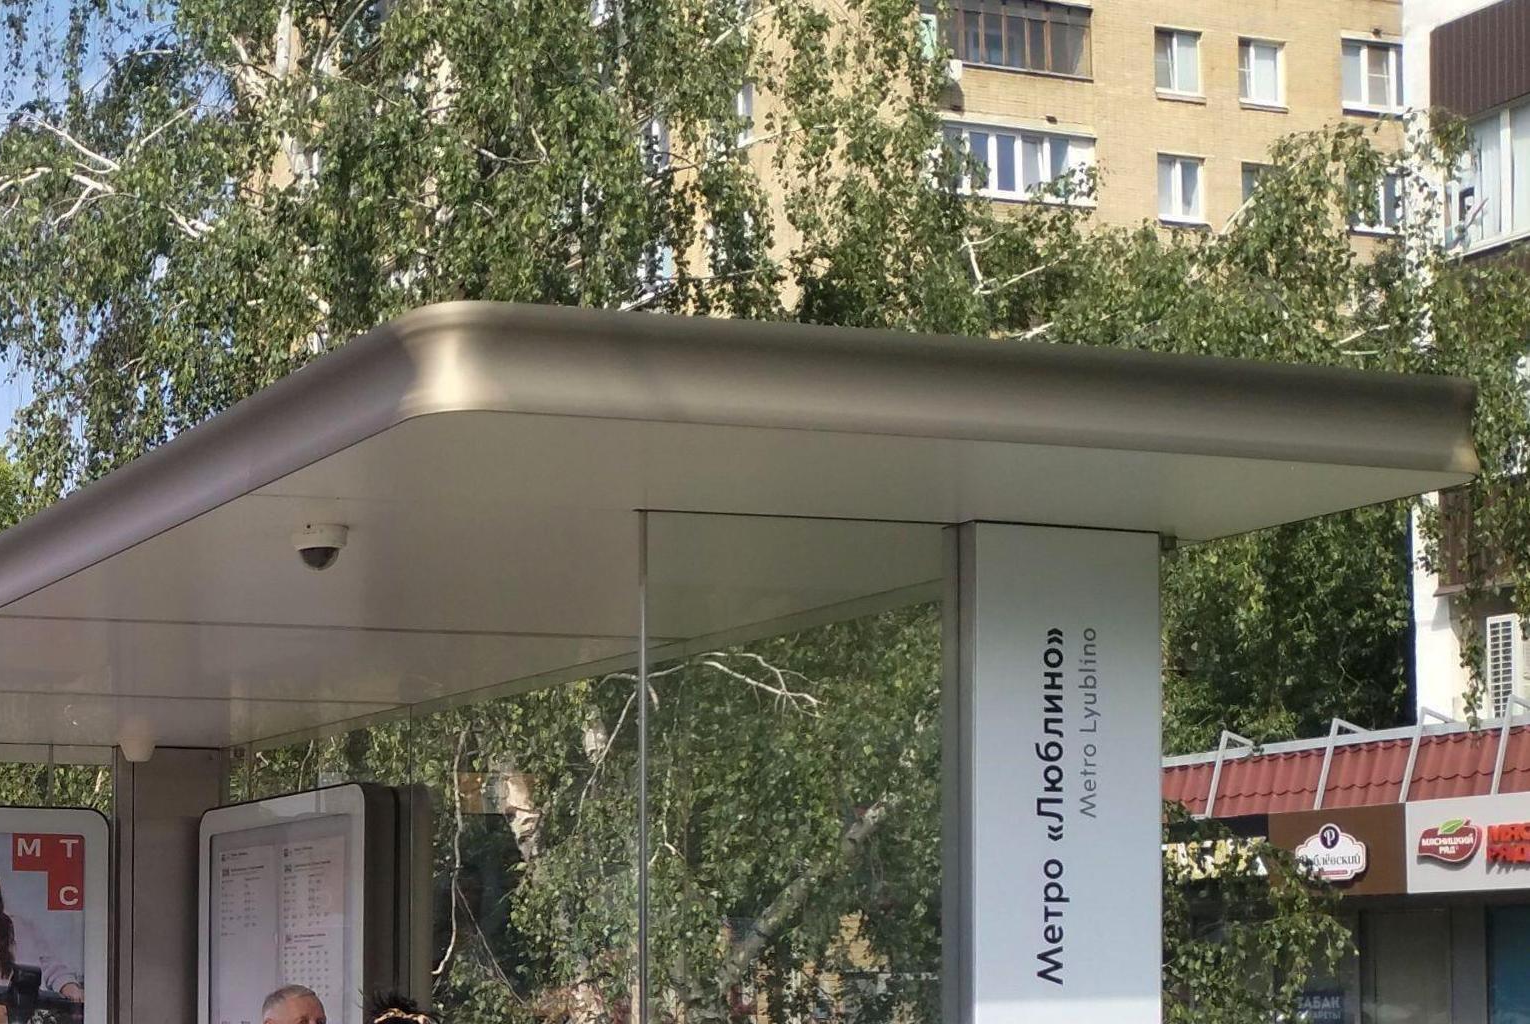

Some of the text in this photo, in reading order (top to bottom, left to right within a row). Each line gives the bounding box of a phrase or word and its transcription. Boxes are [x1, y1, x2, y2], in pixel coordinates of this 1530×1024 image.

[1034, 626, 1071, 986] Метро «Люблино»
[1078, 626, 1102, 819] Metro Lyublino
[1421, 833, 1474, 846] МЯСНИЦКИЙ
